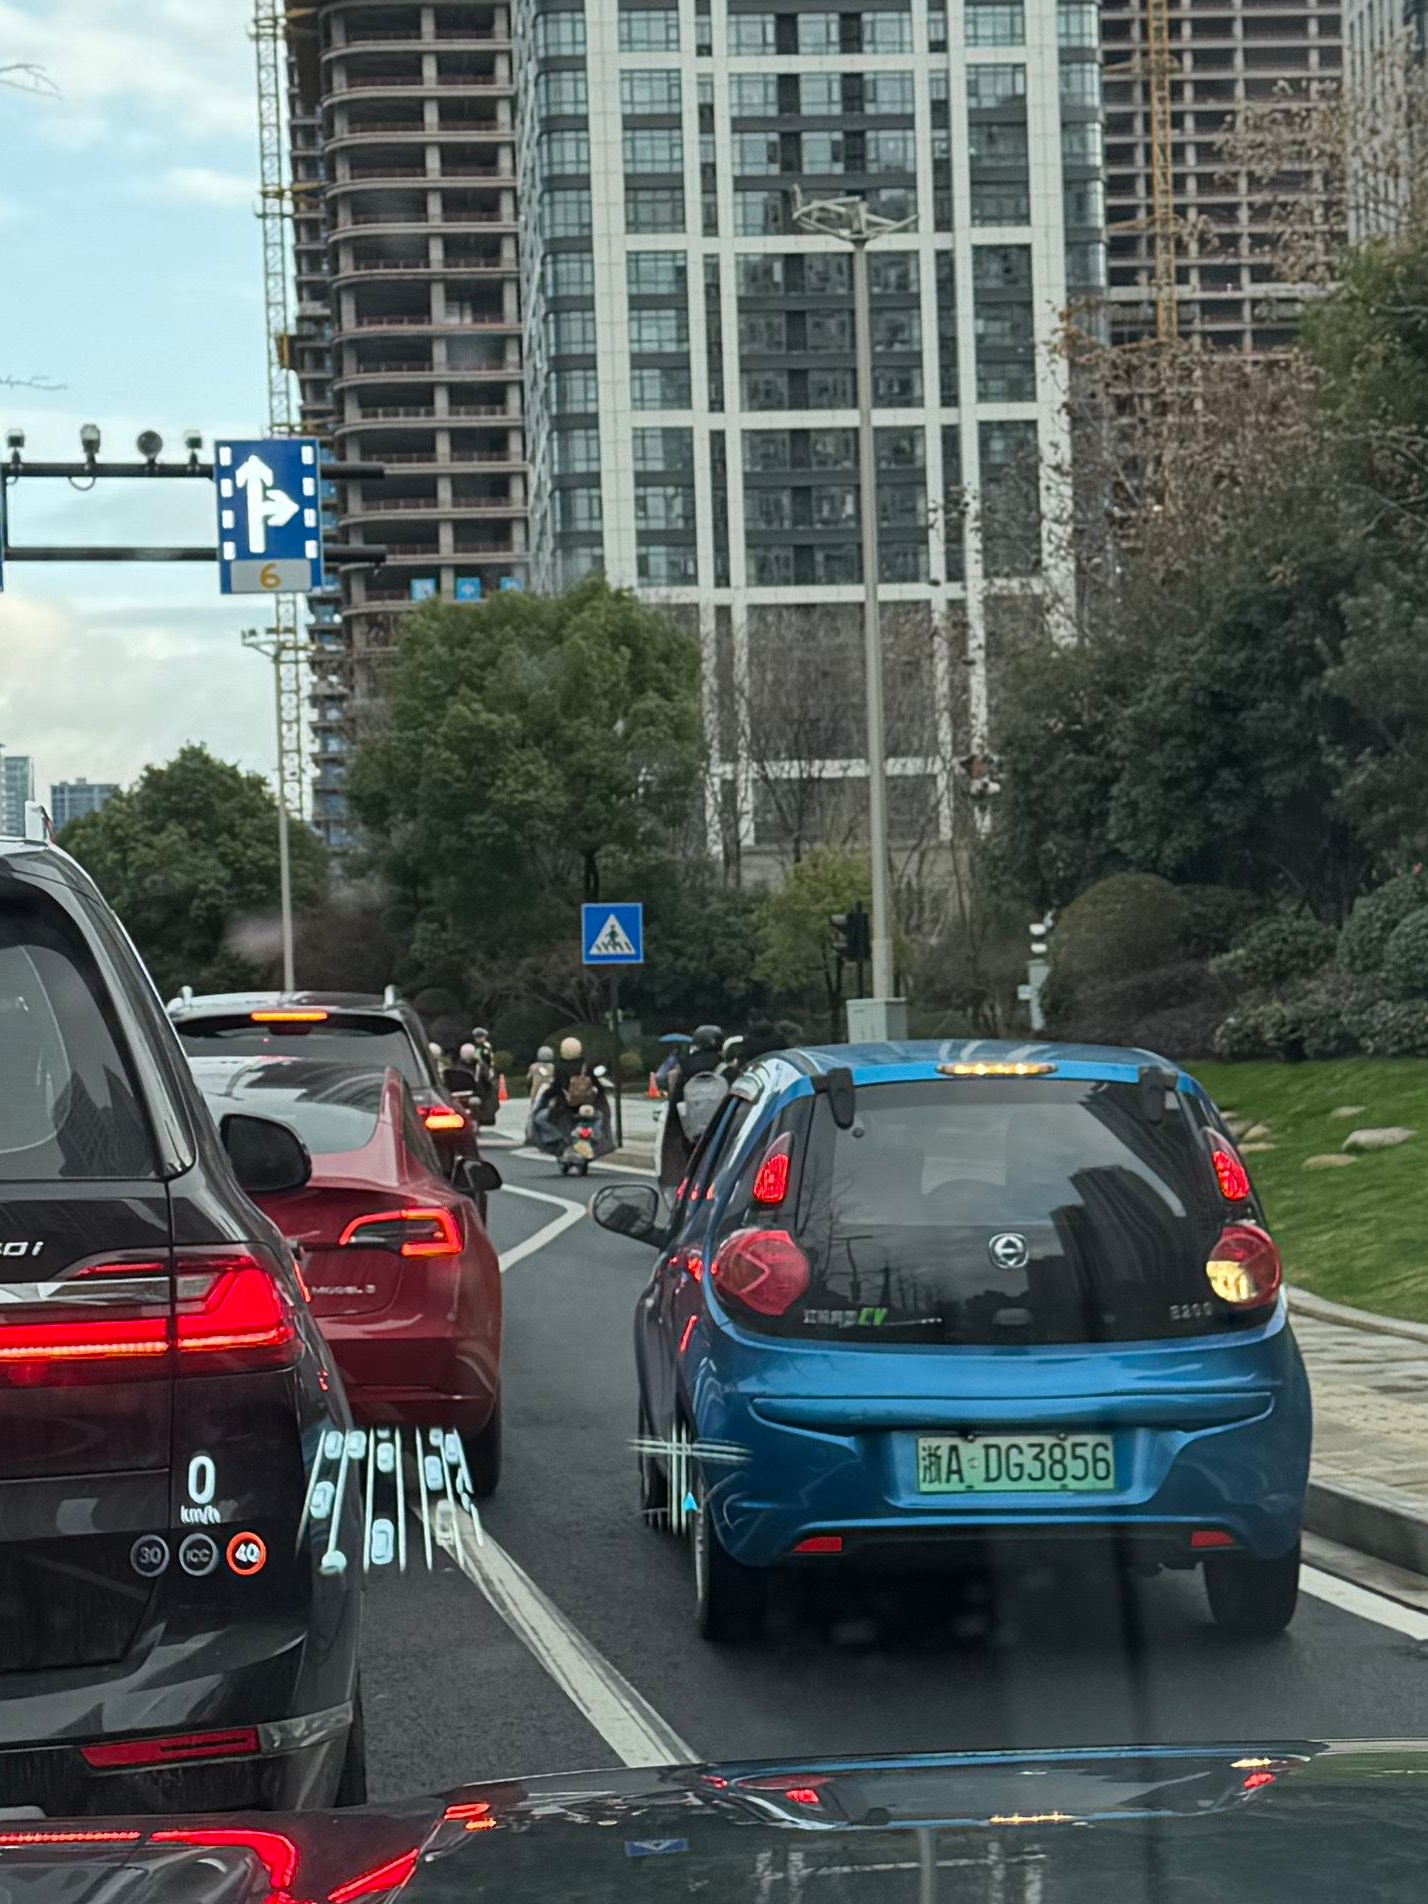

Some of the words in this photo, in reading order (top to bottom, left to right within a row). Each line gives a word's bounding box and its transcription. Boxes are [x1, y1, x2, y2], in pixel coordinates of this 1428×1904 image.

[259, 561, 282, 590] 6
[187, 1454, 217, 1505] 0
[180, 1504, 222, 1526] km/h
[139, 1546, 163, 1565] 30
